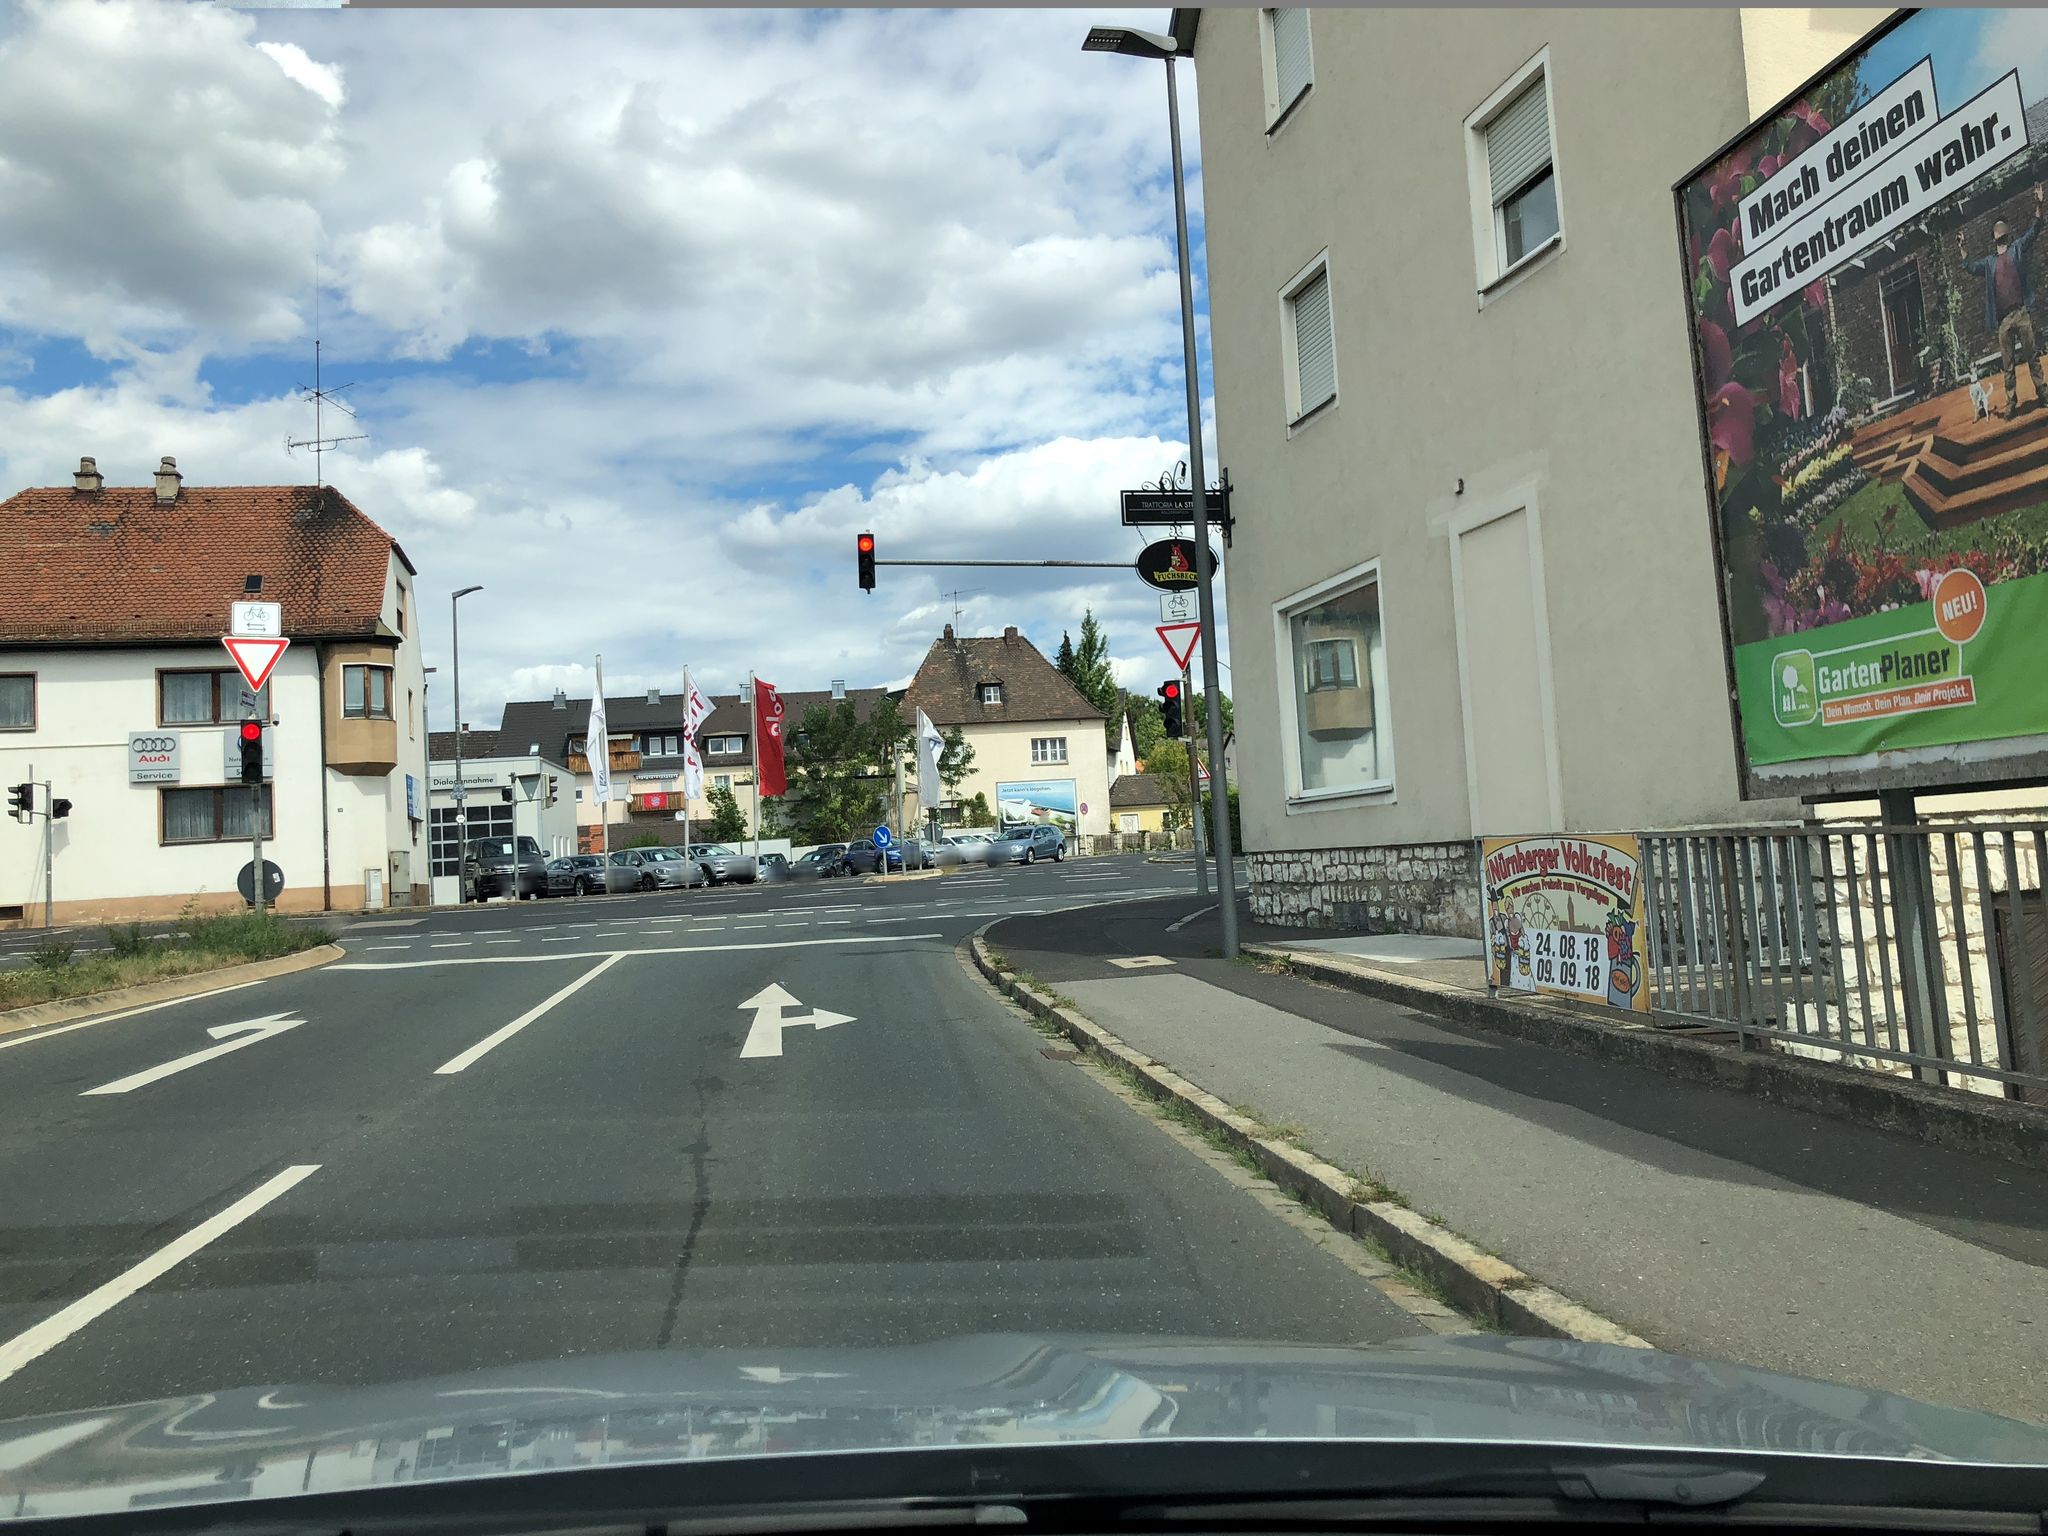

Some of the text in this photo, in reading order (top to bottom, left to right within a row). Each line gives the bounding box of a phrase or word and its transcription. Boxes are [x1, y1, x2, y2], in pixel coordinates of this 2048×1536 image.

[1748, 89, 1925, 239] Mach deinen
[1740, 111, 2011, 307] Gartentraum wahr.
[1142, 501, 1173, 509] TRATTORIA
[1174, 501, 1183, 509] LA
[1942, 590, 1978, 622] NEU!
[1818, 647, 1950, 694] GartenPlaner
[1826, 684, 1969, 719] Dein Wunsch. Dein Plan. Dein Projekt.
[138, 754, 171, 763] Audi
[136, 772, 173, 780] Service
[1488, 841, 1632, 896] Nürnberger Volksfest
[1536, 932, 1599, 963] 24. 08. 18
[1537, 958, 1555, 983] 09.
[1560, 961, 1581, 988] 09.
[1585, 964, 1600, 991] 18
